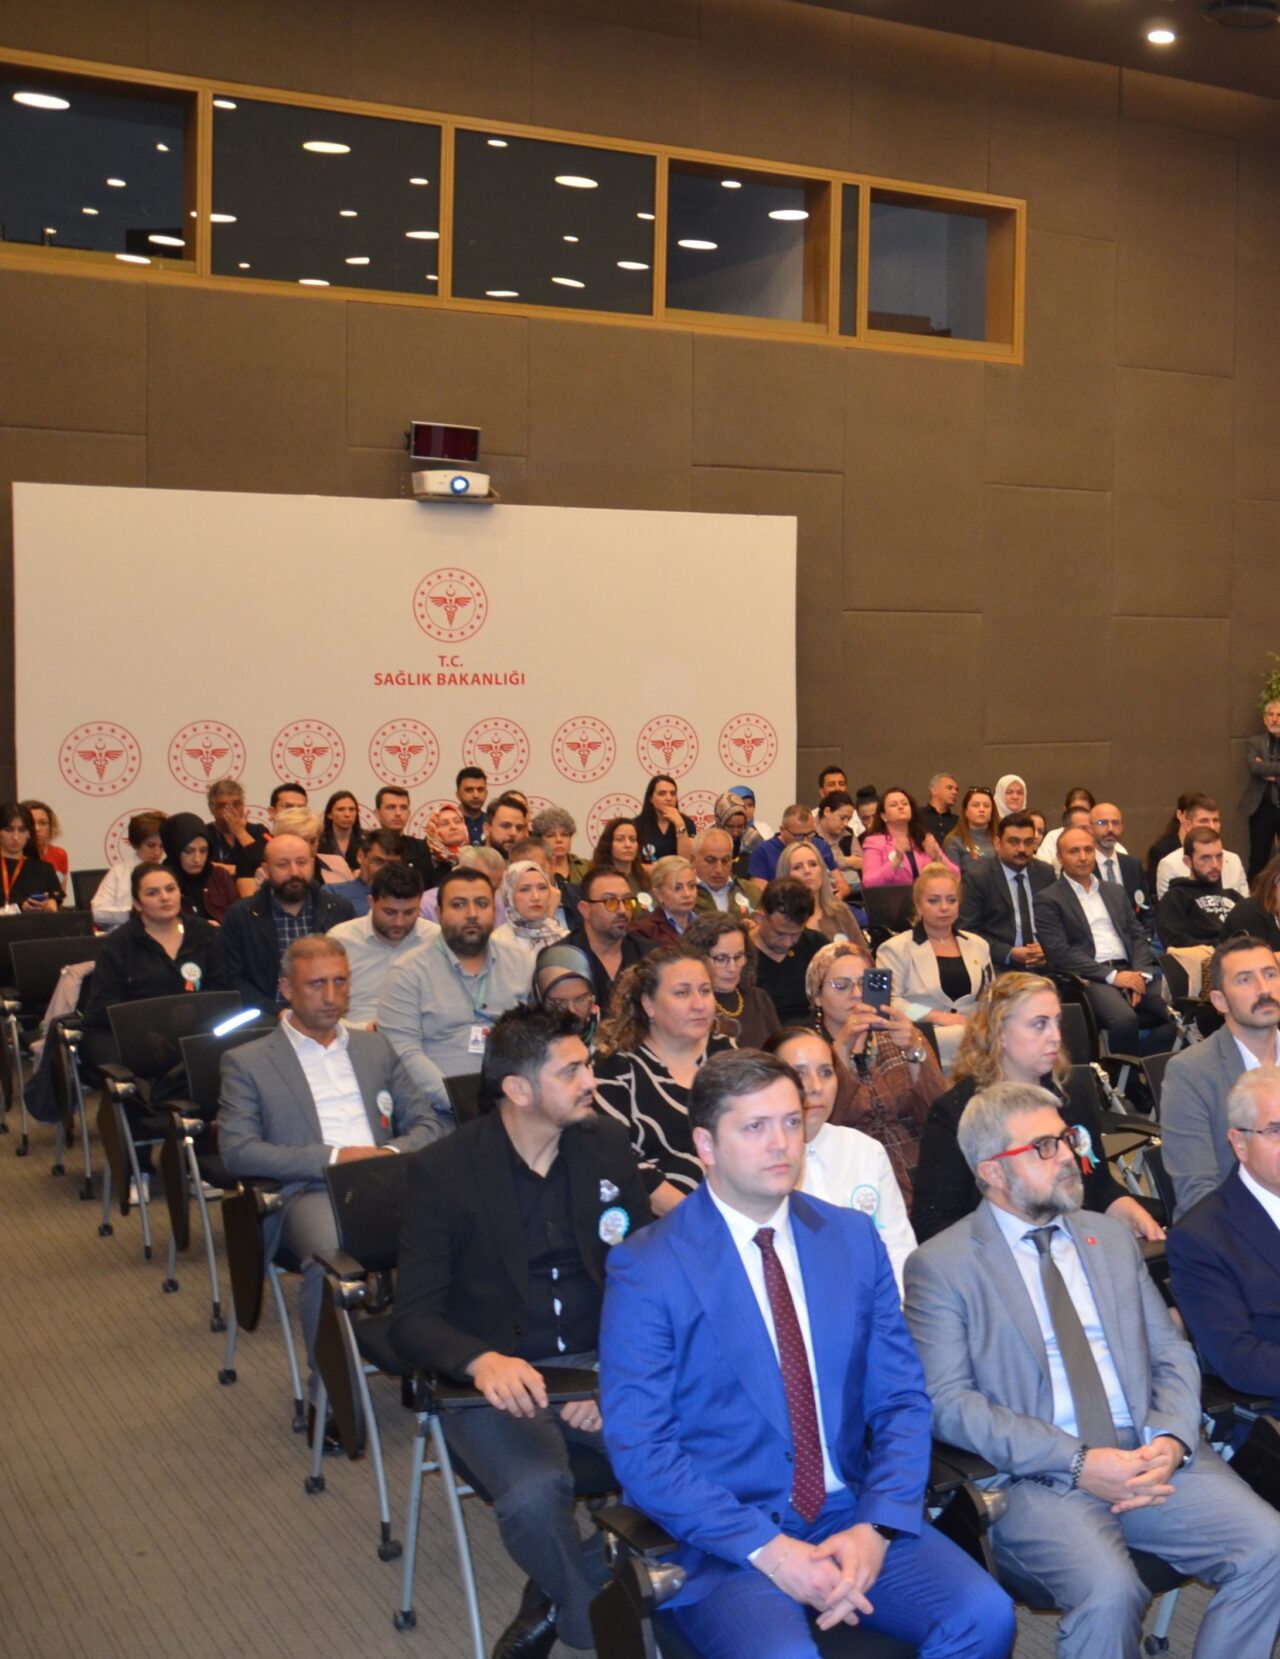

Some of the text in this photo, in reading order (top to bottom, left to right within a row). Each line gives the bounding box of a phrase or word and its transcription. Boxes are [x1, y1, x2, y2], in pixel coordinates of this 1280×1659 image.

[437, 655, 464, 667] T.C.
[374, 670, 526, 686] SAĞLIK BAKANLIĞI
